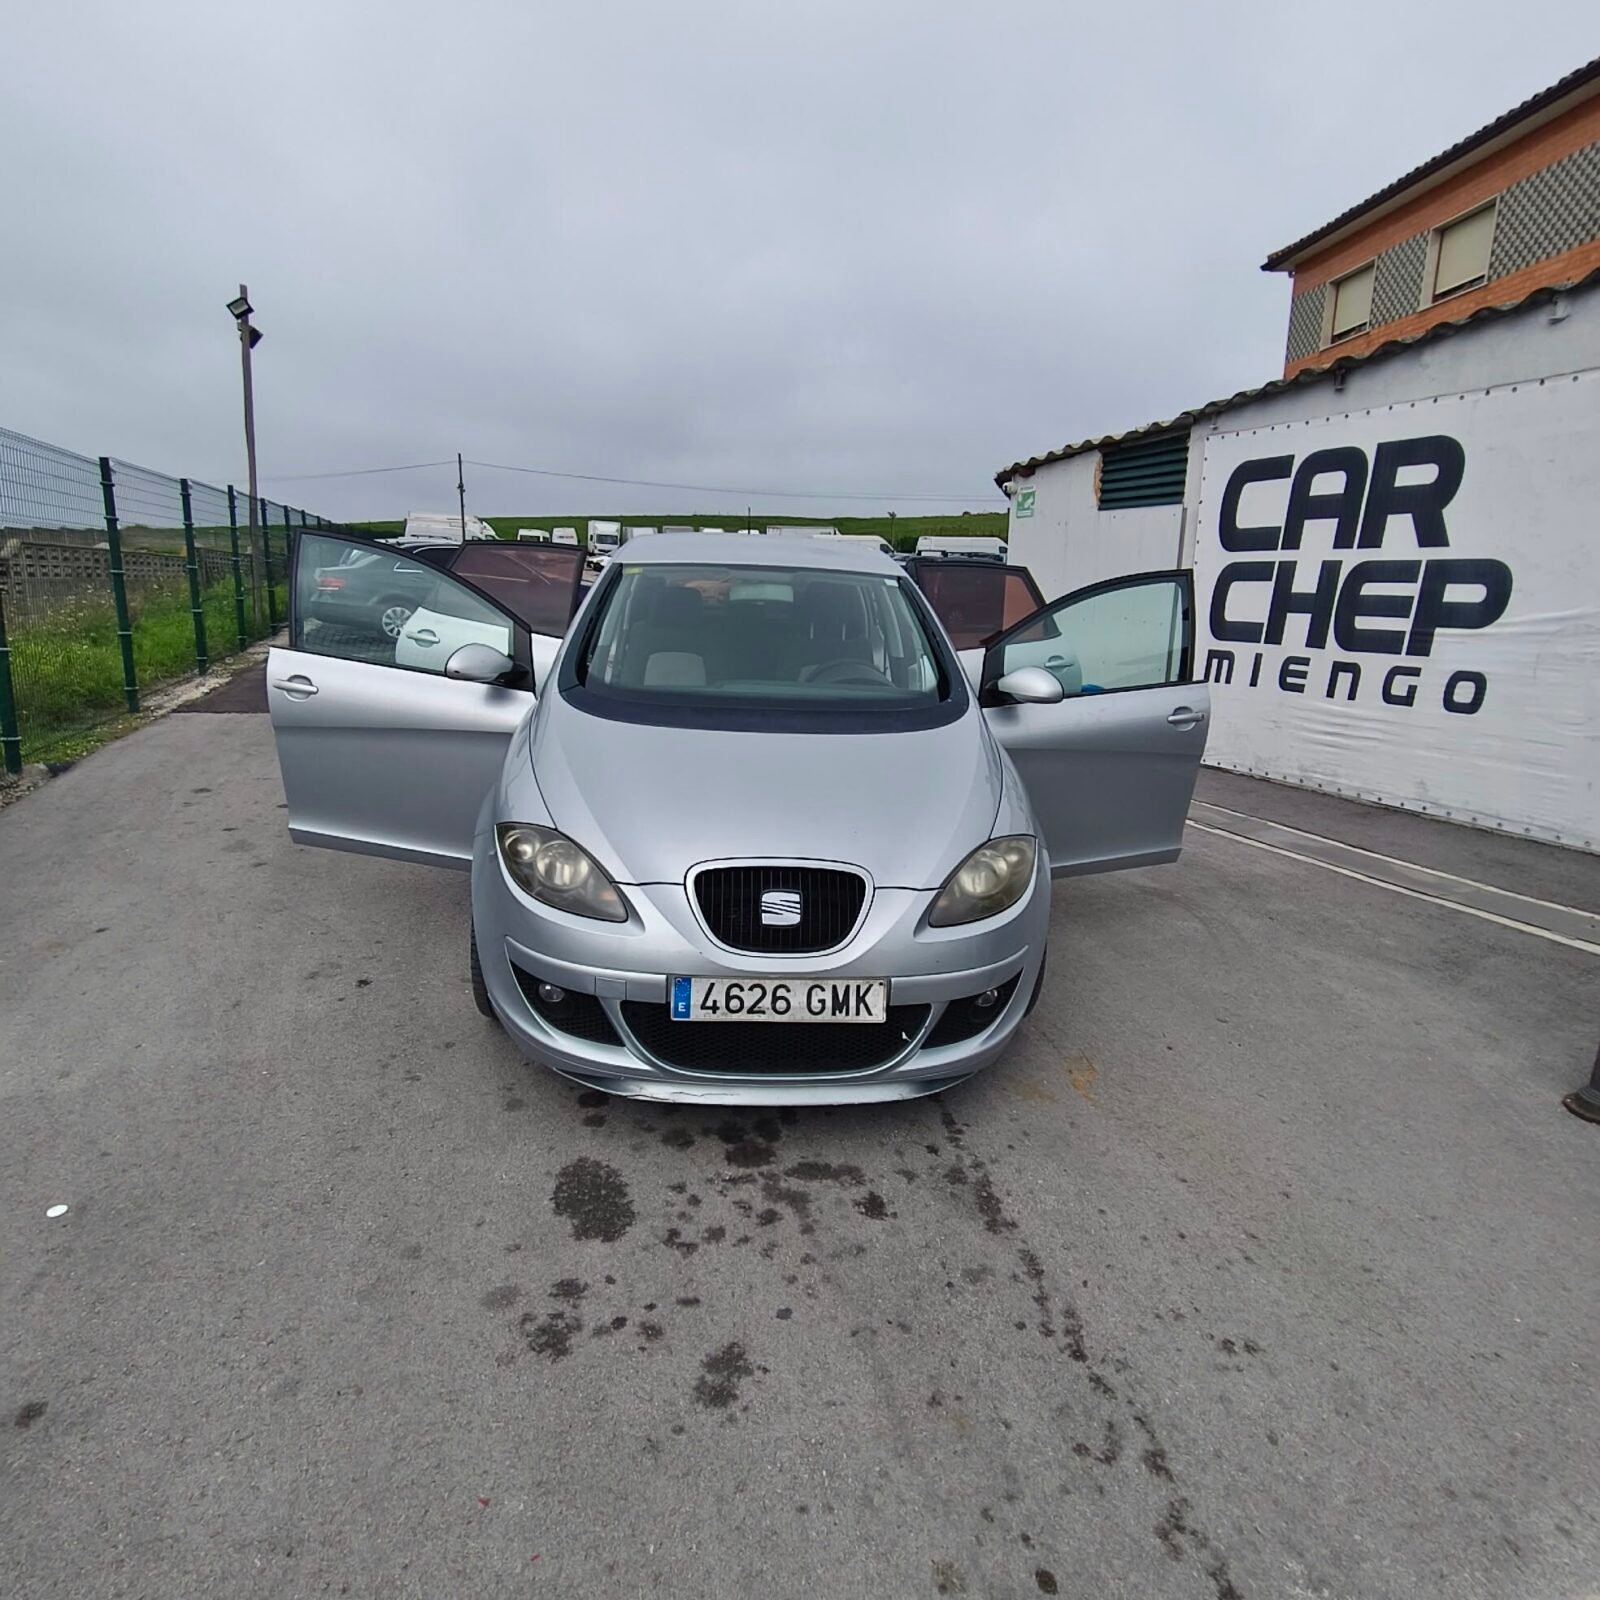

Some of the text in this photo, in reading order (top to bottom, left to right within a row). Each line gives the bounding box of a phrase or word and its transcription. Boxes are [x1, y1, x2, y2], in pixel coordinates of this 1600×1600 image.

[1220, 435, 1465, 552] CAR
[1210, 558, 1513, 657] CHEP
[678, 1002, 686, 1011] E
[700, 982, 874, 1017] 4626 GMK
